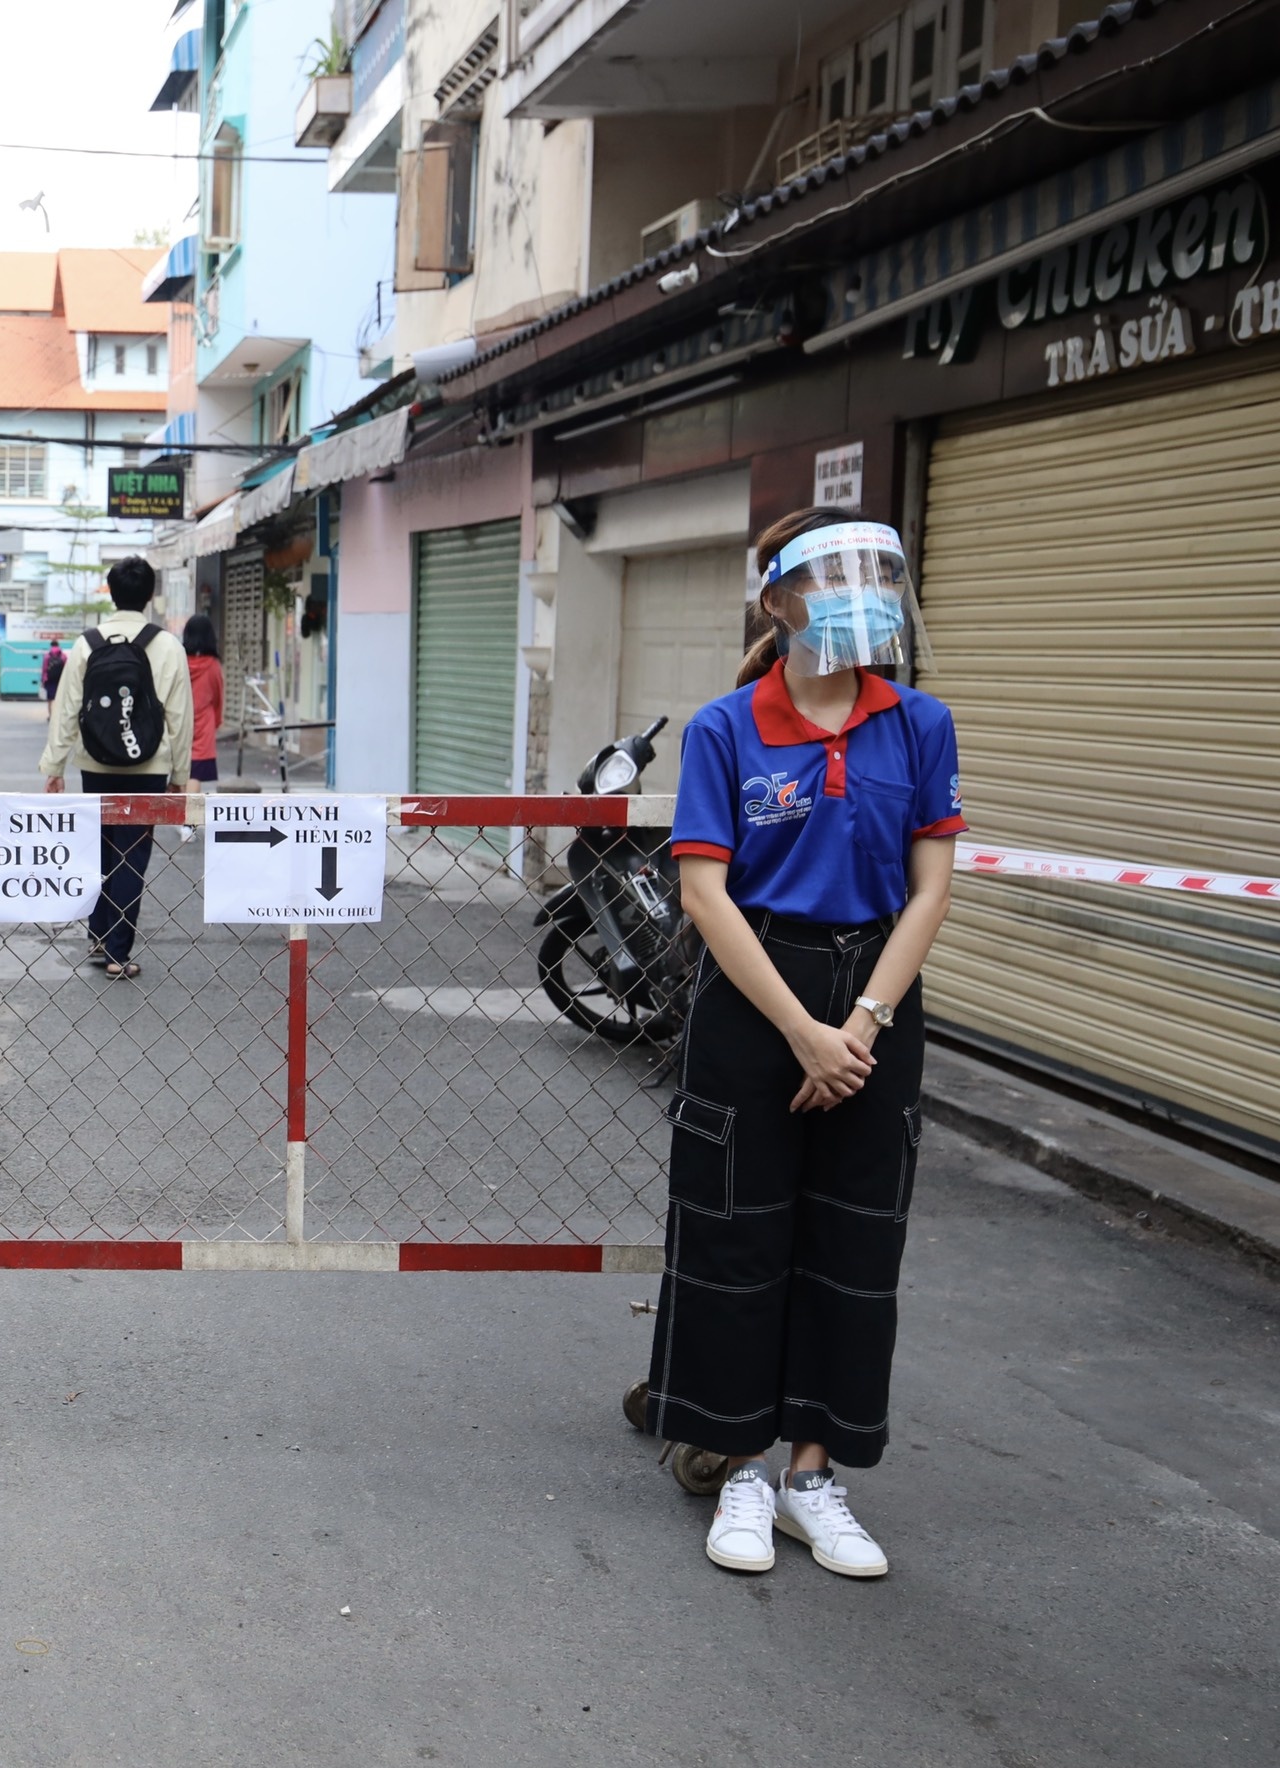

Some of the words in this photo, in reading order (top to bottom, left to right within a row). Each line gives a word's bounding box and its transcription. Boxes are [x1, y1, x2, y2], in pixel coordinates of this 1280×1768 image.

[1045, 314, 1110, 387] TRÀ
[1120, 294, 1187, 368] SỮA
[113, 470, 144, 496] VIỆT
[119, 695, 141, 759] adidas
[10, 813, 76, 833] SINH
[213, 806, 255, 825] PHỤ
[263, 806, 339, 821] HUYNH
[344, 830, 372, 844] 502
[32, 842, 70, 870] BỘ
